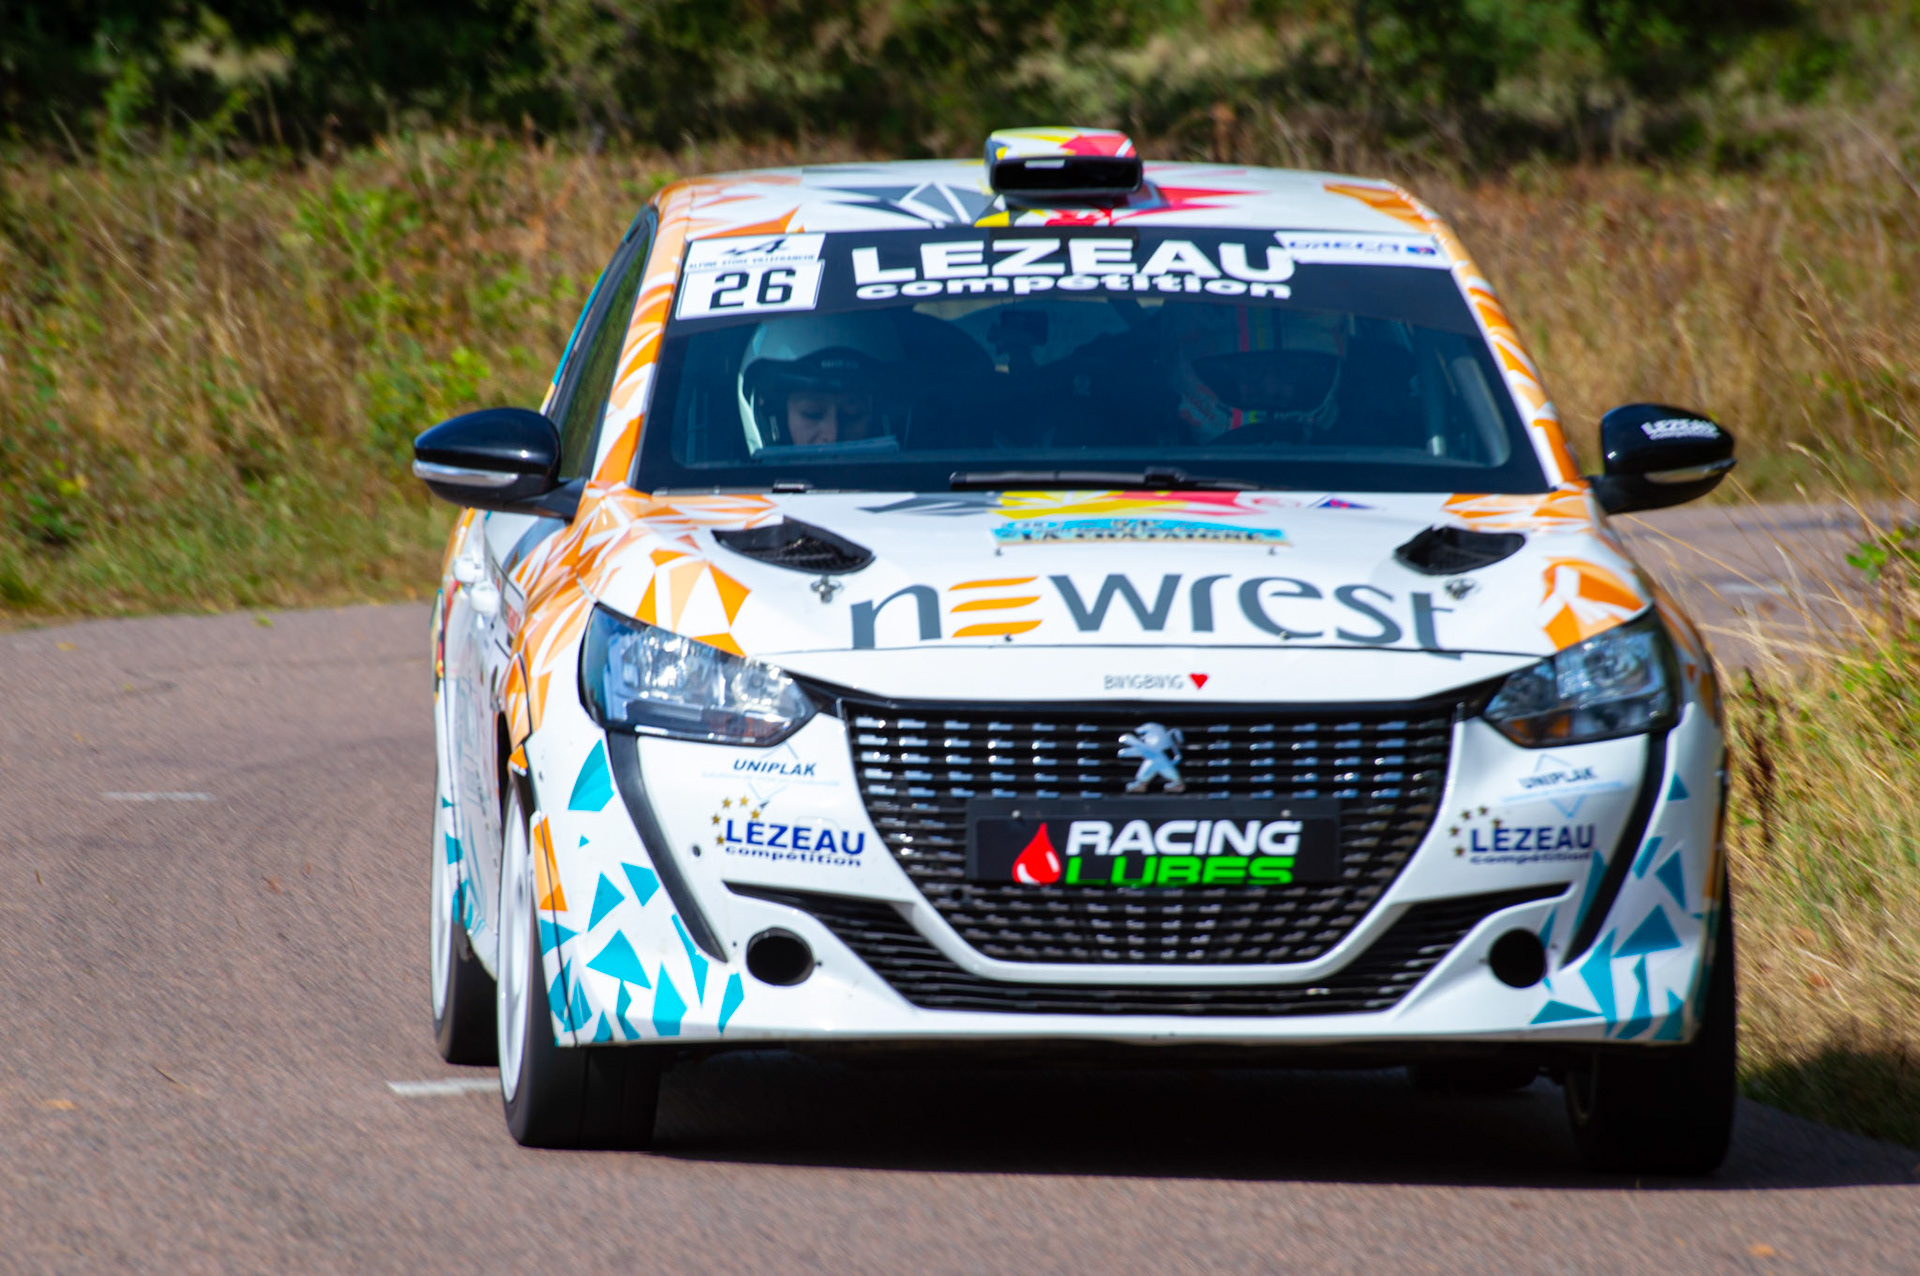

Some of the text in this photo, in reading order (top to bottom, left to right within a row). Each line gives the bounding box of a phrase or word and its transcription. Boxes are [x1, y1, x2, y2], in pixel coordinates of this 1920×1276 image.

[852, 239, 1296, 284] LEZEAU
[709, 267, 796, 310] 26
[850, 573, 1463, 660] newrest
[733, 759, 817, 776] UNIPLAK
[725, 818, 865, 855] LEZEAU
[1065, 819, 1302, 856] RACING
[1471, 823, 1595, 853] LEZEAU
